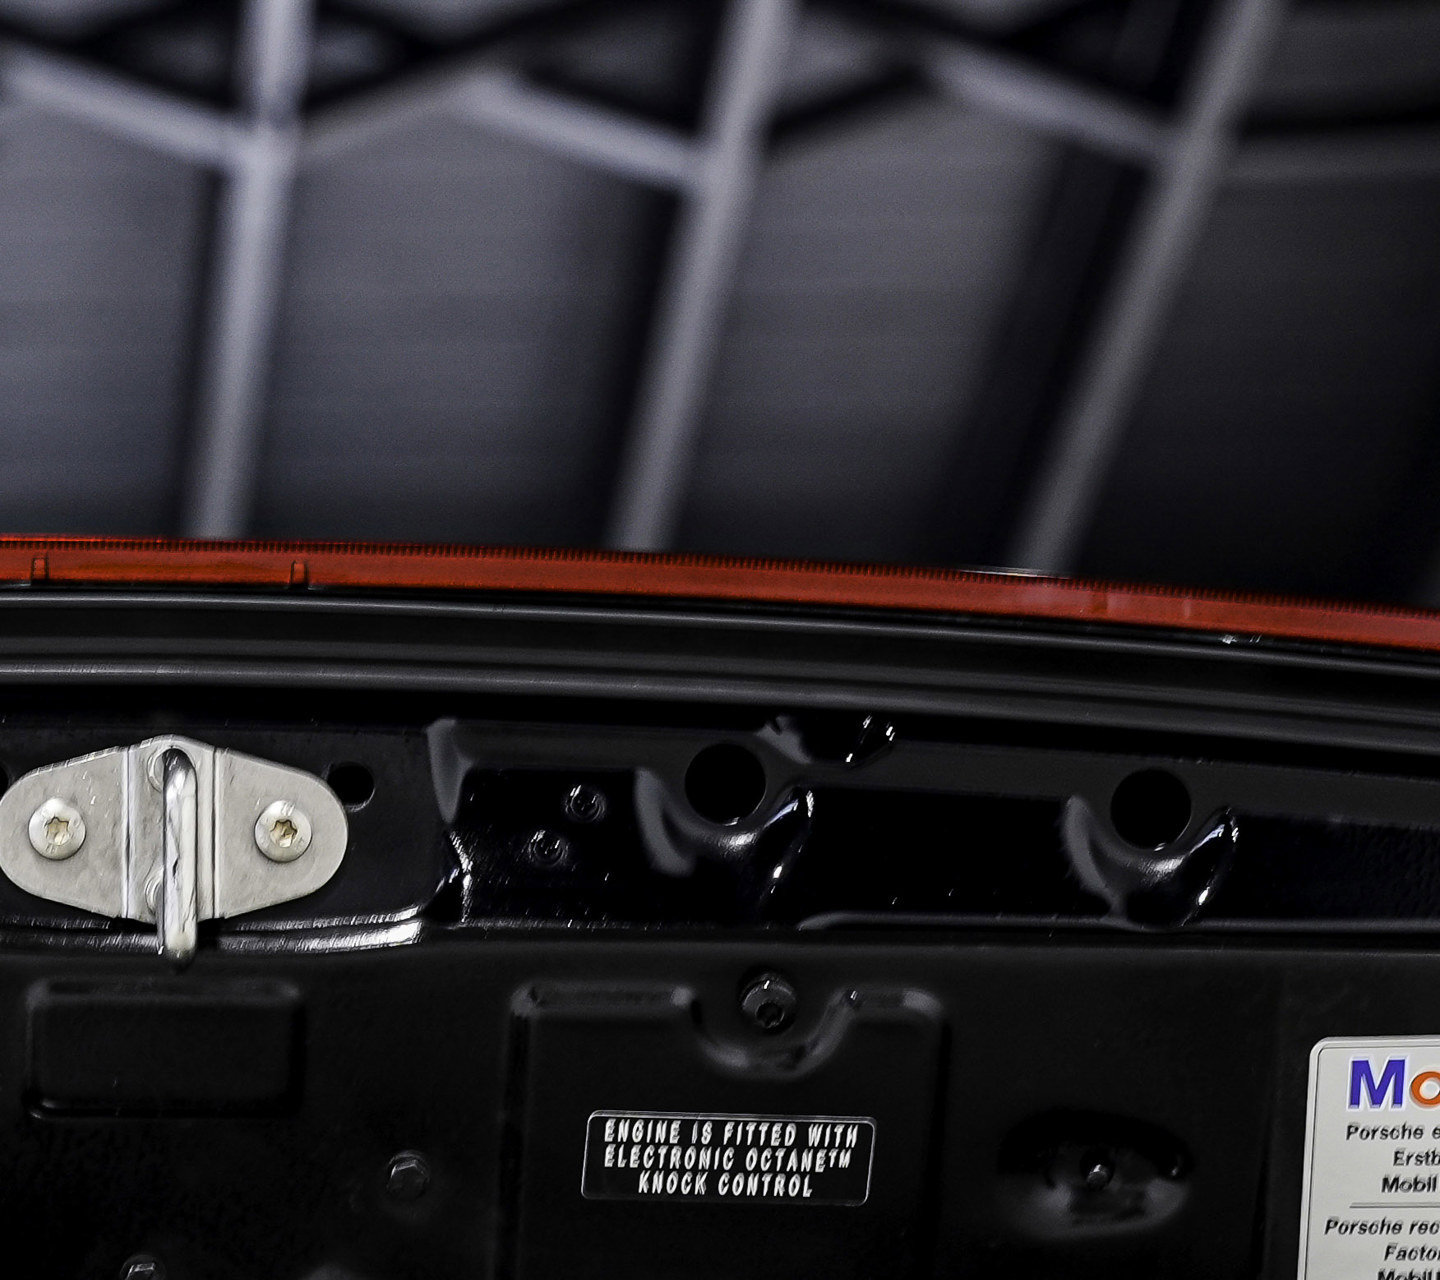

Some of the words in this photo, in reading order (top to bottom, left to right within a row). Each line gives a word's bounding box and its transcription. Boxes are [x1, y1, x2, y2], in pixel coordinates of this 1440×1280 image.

[604, 1118, 681, 1144] ENGINE
[692, 1120, 713, 1145] IS
[723, 1121, 797, 1147] FITTED
[807, 1122, 859, 1148] WITH
[1346, 1120, 1424, 1141] Porsche
[604, 1143, 735, 1171] ELECTRONIC
[638, 1170, 709, 1195] KNOCK
[718, 1172, 813, 1197] CONTROL
[1323, 1216, 1403, 1235] Porsche
